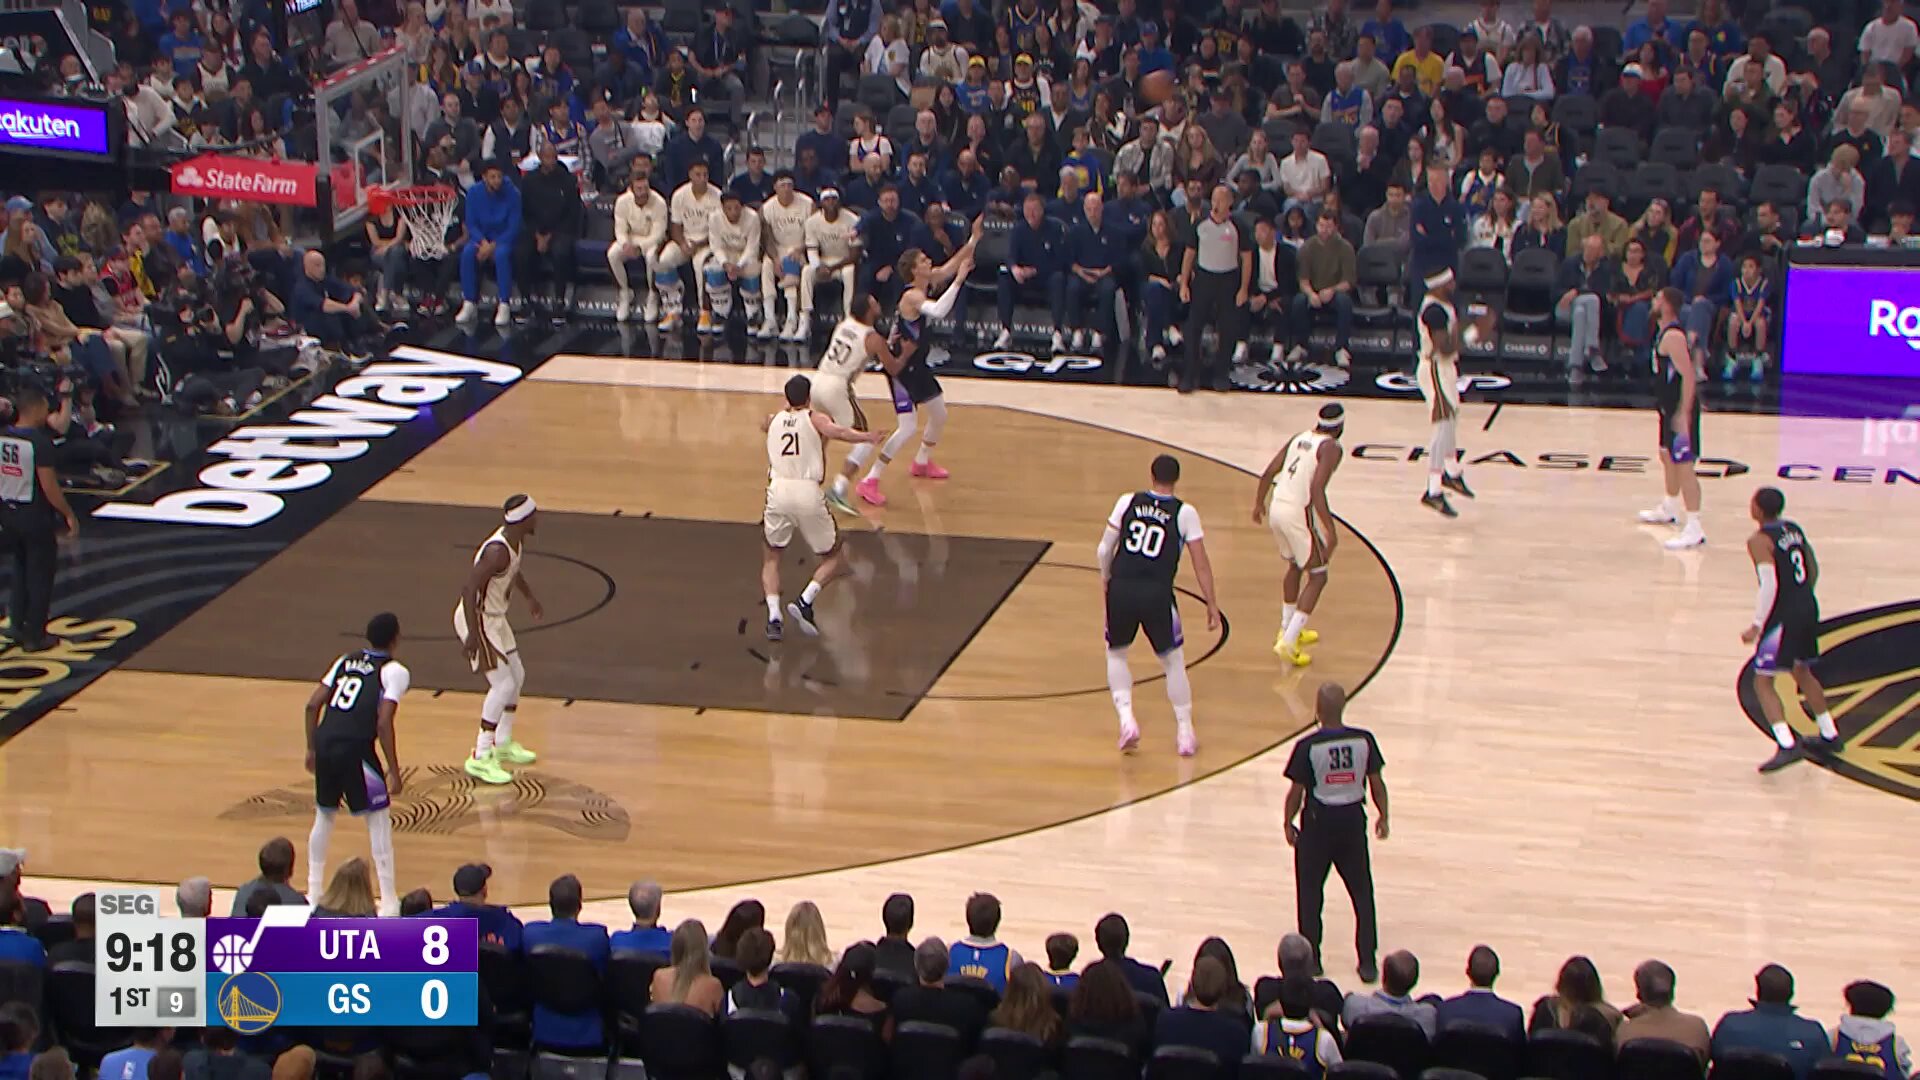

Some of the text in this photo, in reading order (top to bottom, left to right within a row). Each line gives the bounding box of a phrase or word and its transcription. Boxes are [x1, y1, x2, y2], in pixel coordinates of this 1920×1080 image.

[0, 110, 80, 138] akuten
[577, 300, 618, 311] WAYMO
[1013, 323, 1055, 335] WAYMO
[90, 344, 523, 528] betway
[781, 432, 800, 456] 21
[2, 442, 20, 465] 56
[1288, 456, 1301, 480] 4
[1125, 520, 1166, 558] 30
[1790, 549, 1806, 584] 3
[329, 675, 363, 710] 19
[1328, 745, 1353, 770] 33
